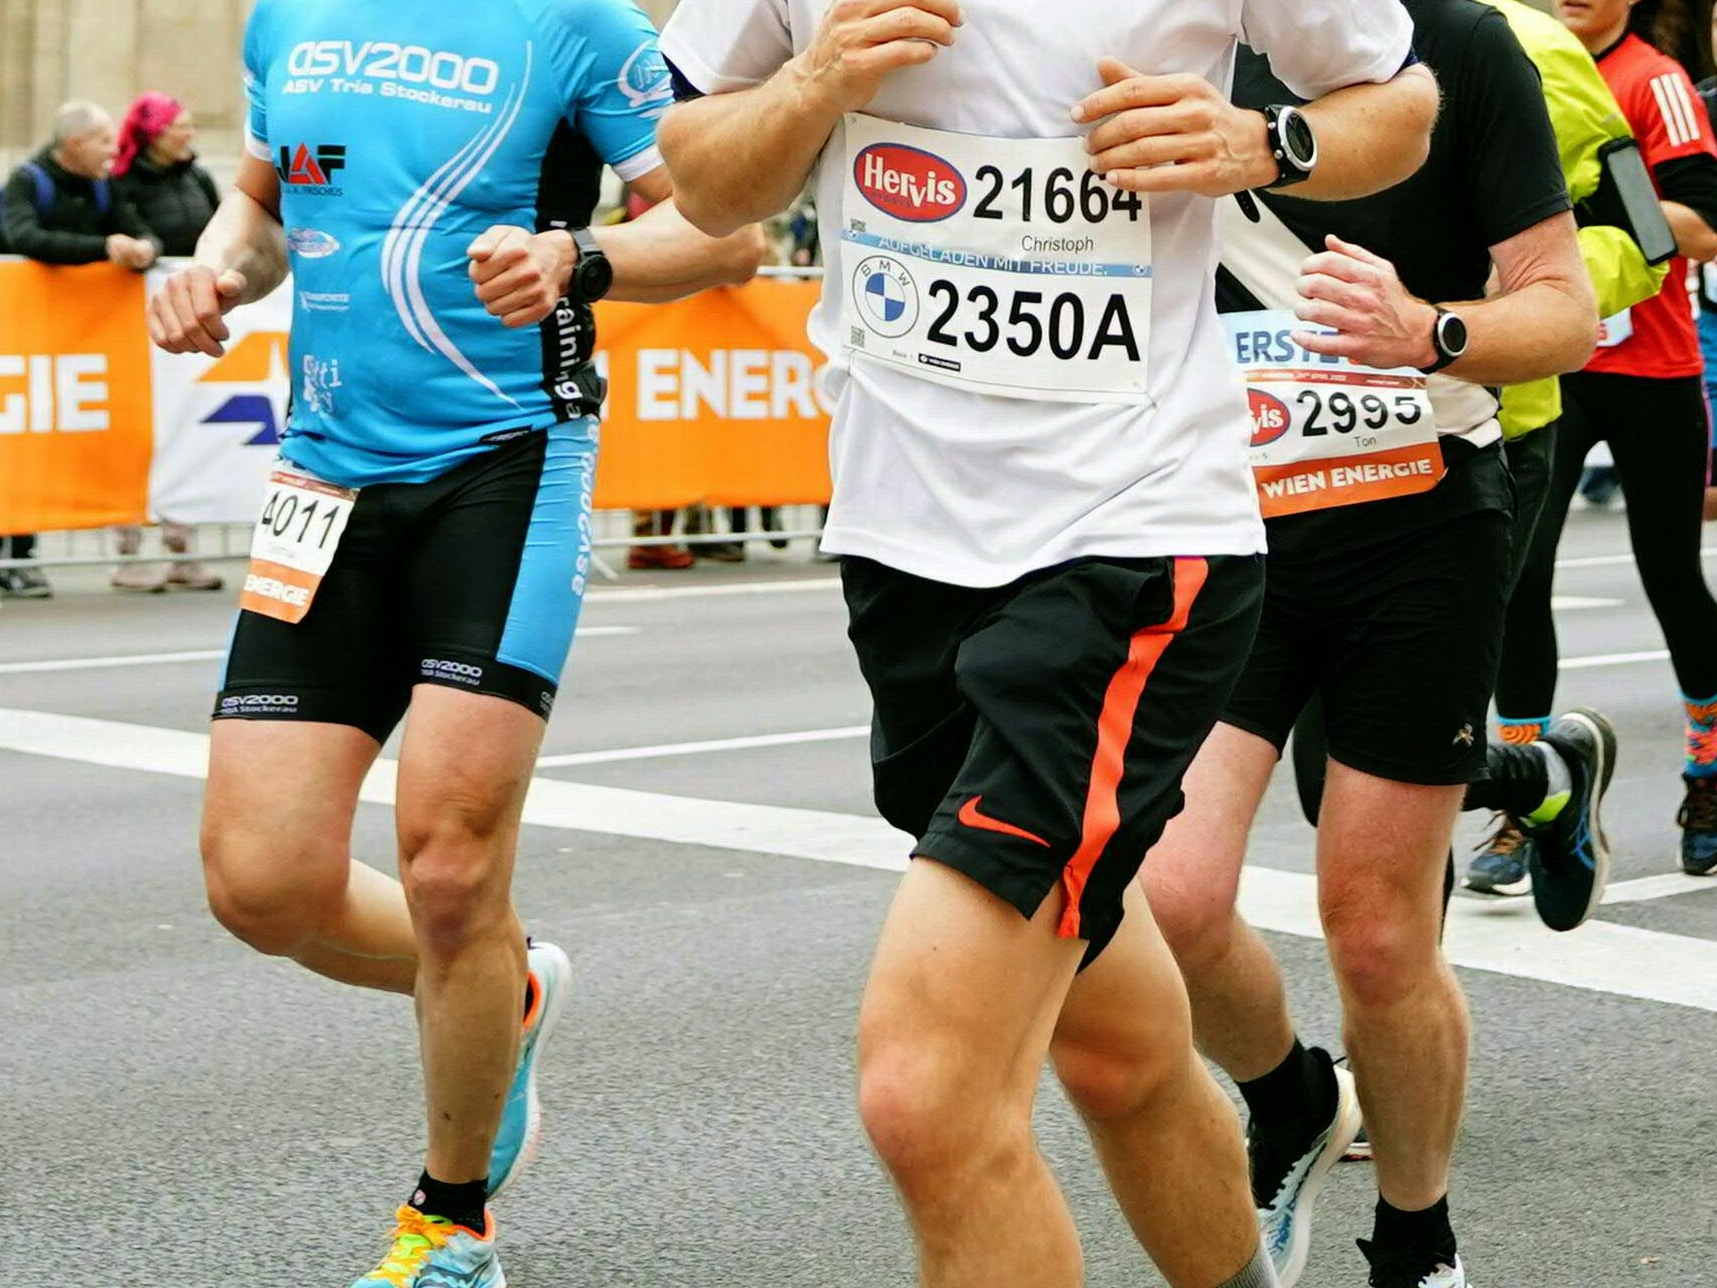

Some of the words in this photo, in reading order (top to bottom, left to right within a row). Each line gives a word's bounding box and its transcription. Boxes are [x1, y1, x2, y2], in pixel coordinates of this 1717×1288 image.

[379, 81, 492, 115] Stockerau
[864, 153, 957, 208] Hervis
[973, 164, 1142, 224] 21664
[877, 235, 989, 269] AUFGELADEN
[993, 257, 1024, 272] MIT
[1031, 259, 1109, 276] FREUDE.
[1021, 234, 1095, 253] Christoph
[926, 279, 1141, 362] 2350A
[554, 296, 584, 400] raining
[637, 348, 832, 420] ENER
[1296, 390, 1422, 437] 2995
[1354, 436, 1377, 448] Ton
[1261, 470, 1327, 499] WIEN
[1331, 458, 1433, 488] ENERGIE
[261, 490, 340, 550] 4011
